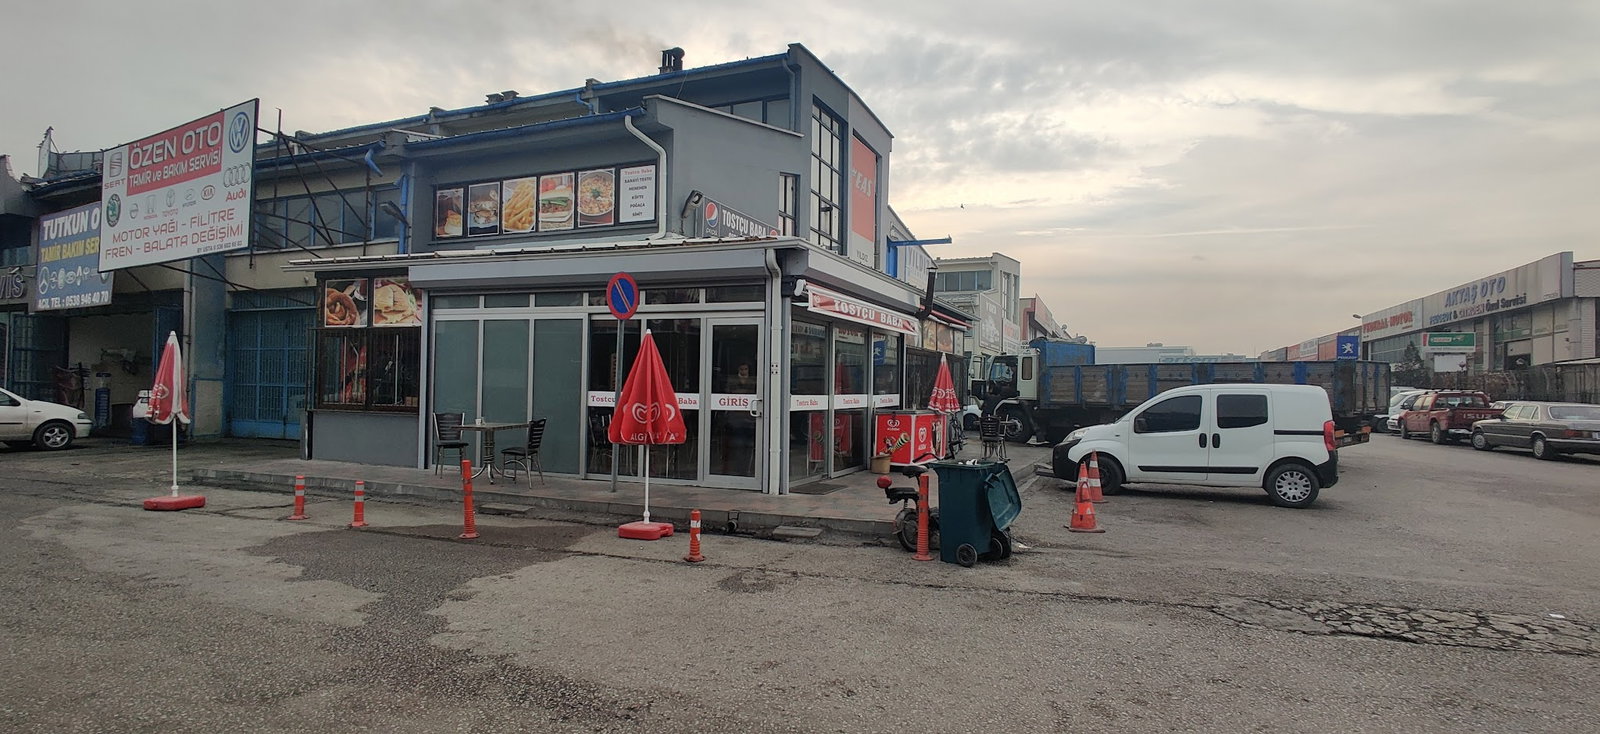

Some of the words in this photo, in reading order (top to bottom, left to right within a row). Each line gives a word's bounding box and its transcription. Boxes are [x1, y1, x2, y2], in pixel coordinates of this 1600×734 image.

[129, 136, 176, 169] ÖZEN
[181, 121, 221, 154] OTO
[129, 169, 150, 187] TAMİR
[152, 171, 161, 182] ve
[162, 163, 188, 179] BAKIM
[189, 148, 221, 171] SERVİSİ
[203, 187, 213, 197] KIA
[226, 188, 246, 202] Audi
[43, 210, 89, 240] TUTKUN
[112, 226, 149, 244] MOTOR
[153, 219, 178, 236] YAĞI
[190, 208, 235, 229] FİLİTRE
[722, 209, 749, 236] TOSTÇU
[749, 221, 767, 237] BABA
[62, 240, 85, 259] BAKIM
[105, 245, 132, 260] FREN
[144, 235, 188, 253] BALATA
[191, 220, 243, 244] DEĞİŞİMİ
[101, 291, 109, 302] 70
[1445, 284, 1478, 308] AKTAŞ
[1480, 276, 1506, 297] OTO
[1453, 310, 1458, 319] &
[1500, 292, 1527, 308] Servisi
[833, 299, 875, 320] TOSTÇU
[880, 311, 904, 328] BABA
[678, 397, 697, 405] Baba
[718, 396, 749, 409] GİRİŞ
